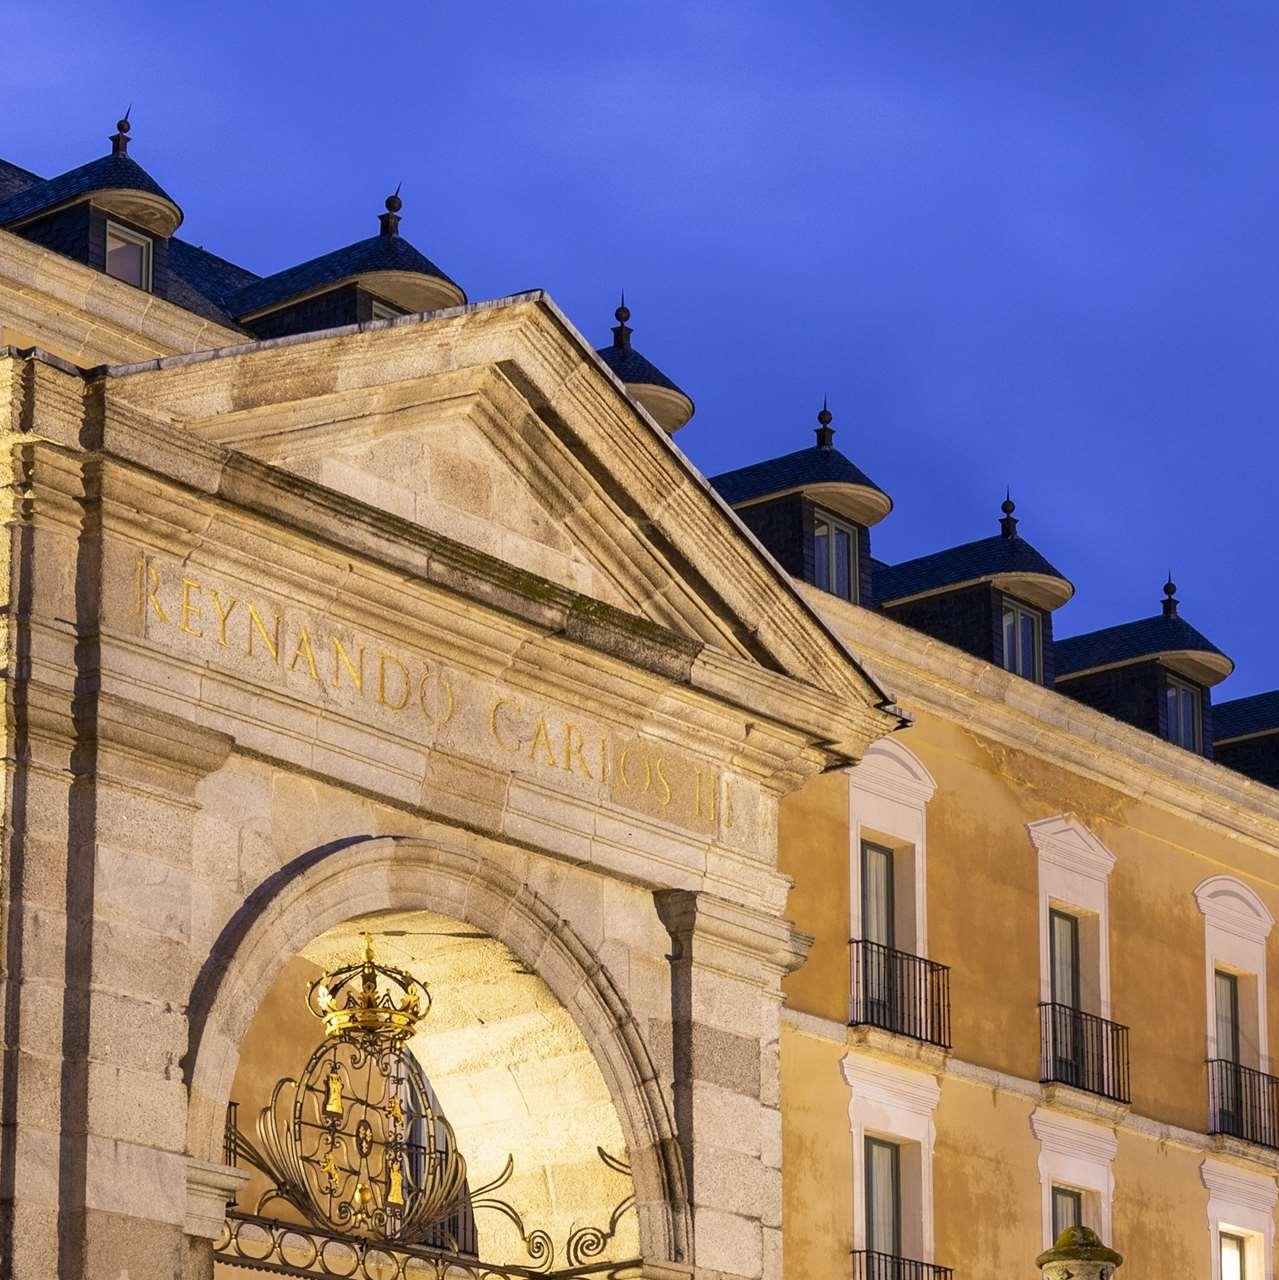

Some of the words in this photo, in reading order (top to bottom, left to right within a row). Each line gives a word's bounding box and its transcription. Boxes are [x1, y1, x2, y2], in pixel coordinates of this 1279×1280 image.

[134, 558, 455, 728] REYNANDO
[489, 697, 671, 807] CARLOS
[693, 765, 734, 829] III
